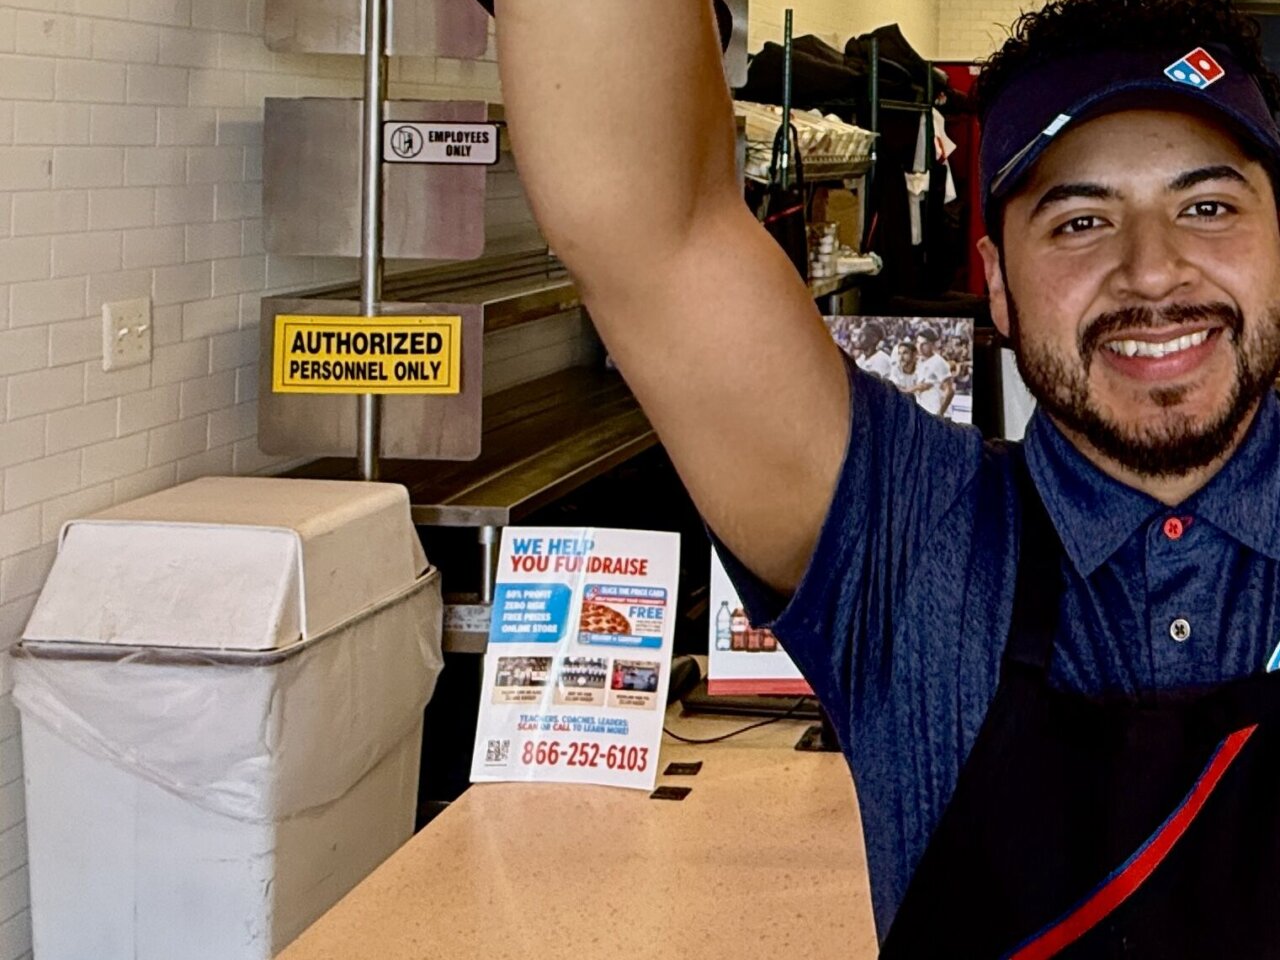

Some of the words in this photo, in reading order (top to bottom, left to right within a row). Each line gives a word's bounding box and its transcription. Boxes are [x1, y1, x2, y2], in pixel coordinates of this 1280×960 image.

[428, 130, 489, 144] EMPLOYEES
[446, 144, 471, 157] ONLY
[291, 331, 443, 355] AUTHORIZED
[289, 360, 388, 381] PERSONNEL
[394, 361, 442, 381] ONLY
[512, 538, 543, 555] WE
[511, 555, 549, 572] YOU
[629, 606, 663, 619] FREE
[522, 740, 649, 772] 866-252-6103
